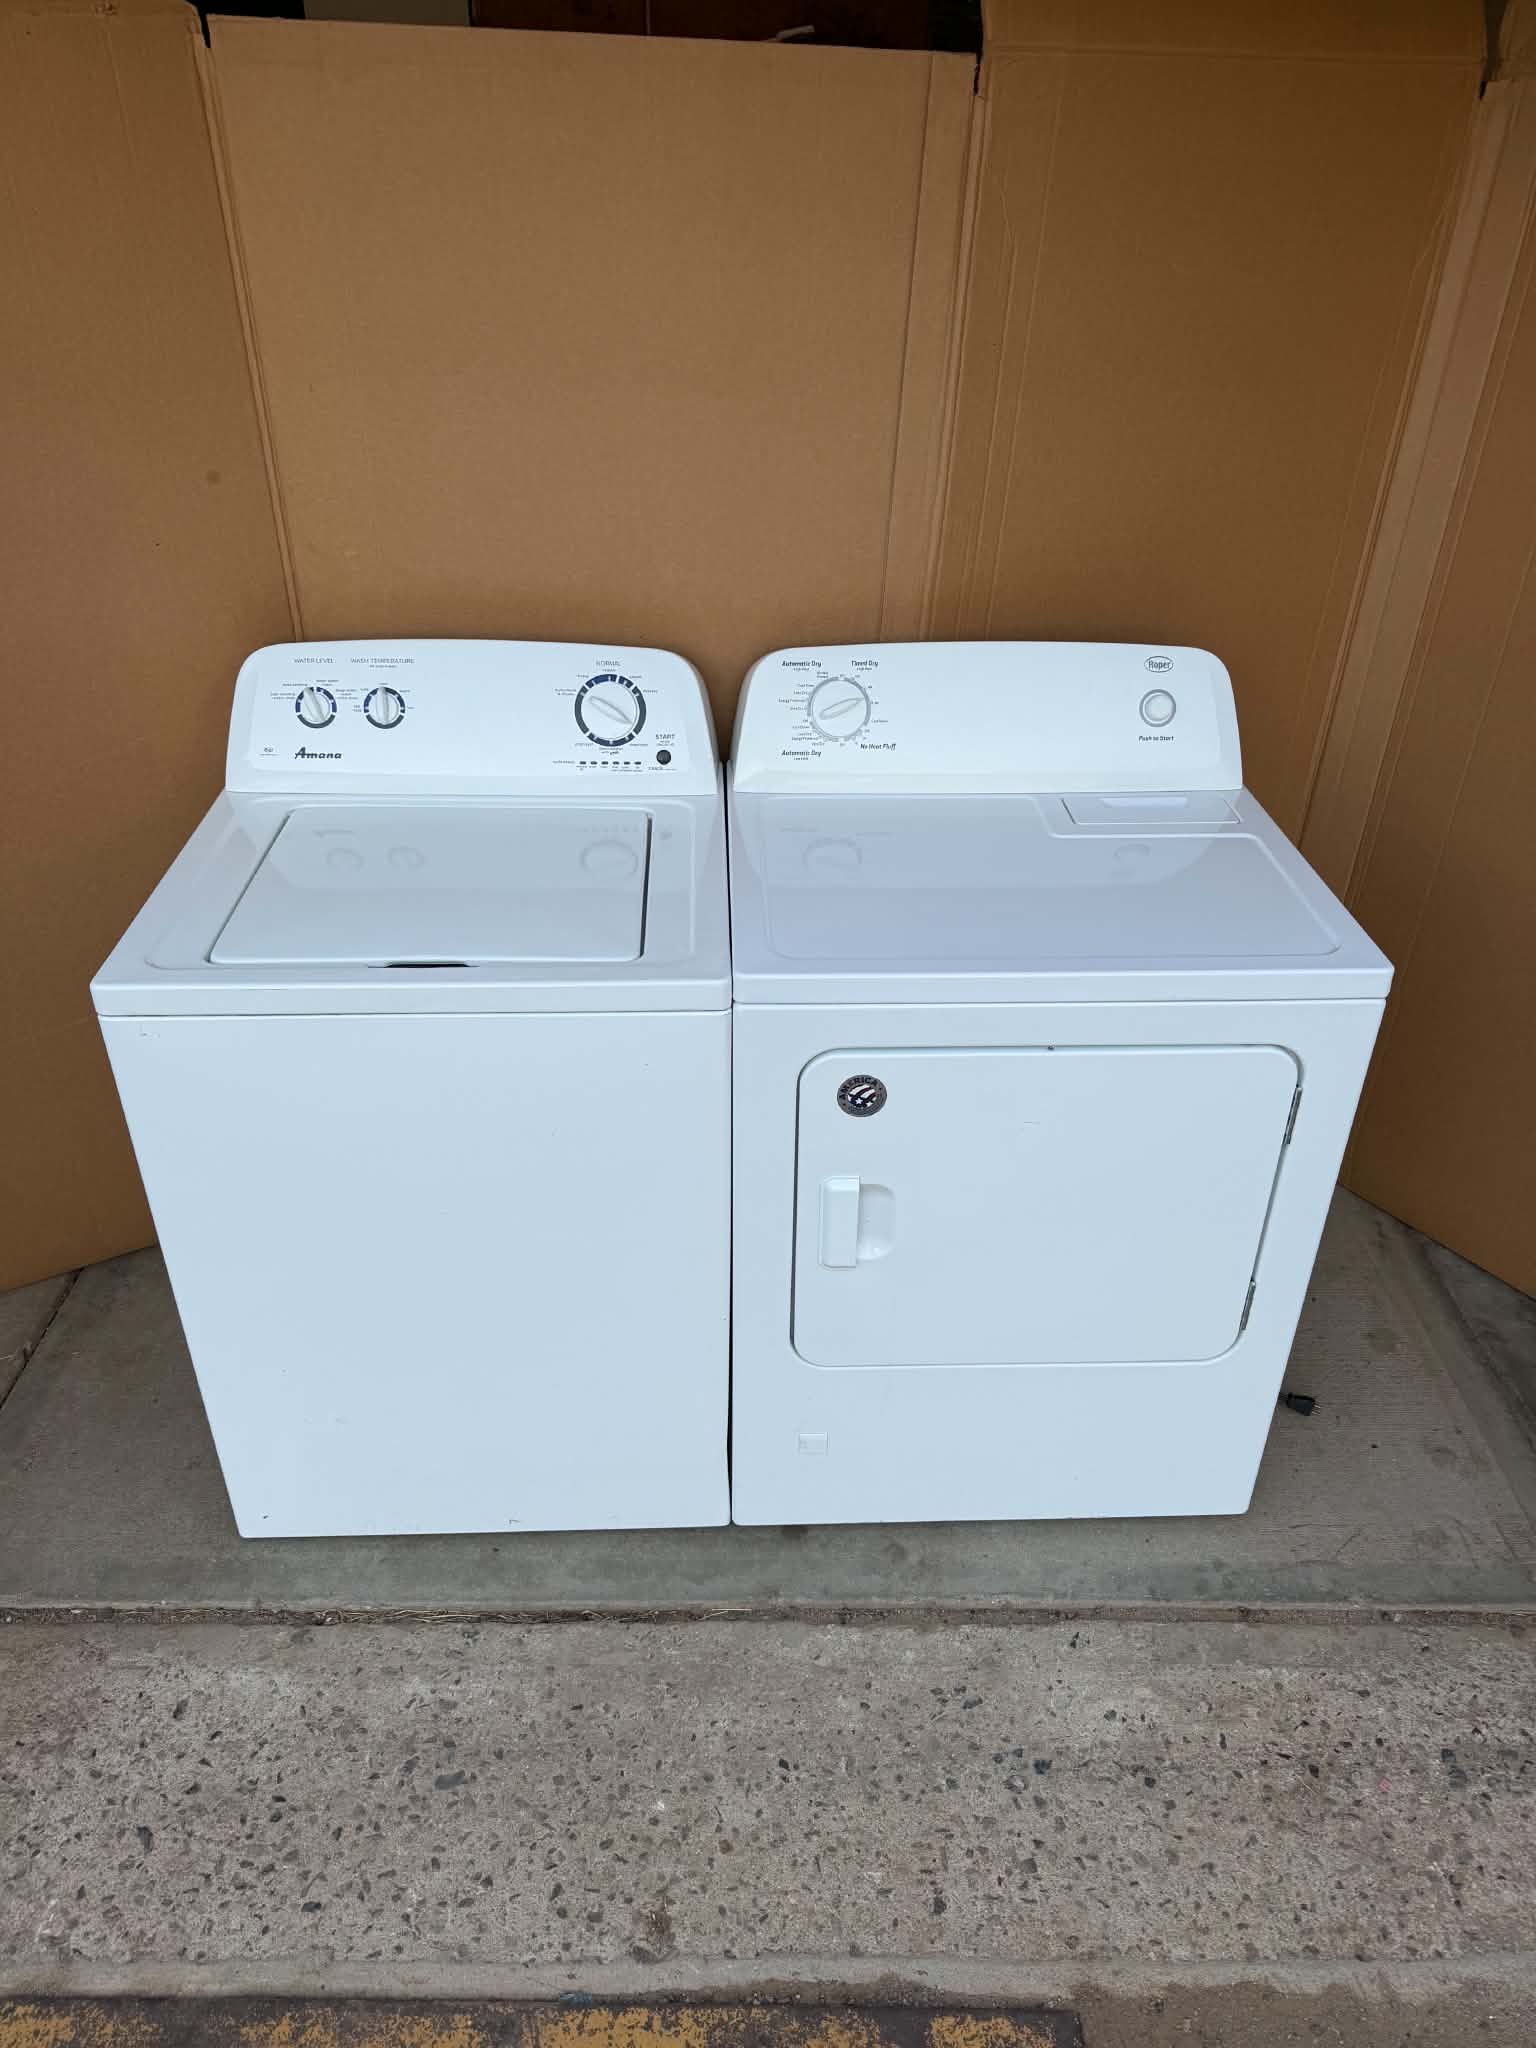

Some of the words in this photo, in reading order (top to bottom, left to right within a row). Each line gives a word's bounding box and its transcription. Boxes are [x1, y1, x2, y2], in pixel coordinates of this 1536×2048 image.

[315, 657, 334, 665] LEVEL
[811, 660, 822, 668] Dry
[868, 660, 879, 668] Dry
[1148, 660, 1171, 671] Roper
[294, 746, 342, 760] Amana
[781, 749, 810, 757] Automatic
[810, 749, 822, 758] Dry
